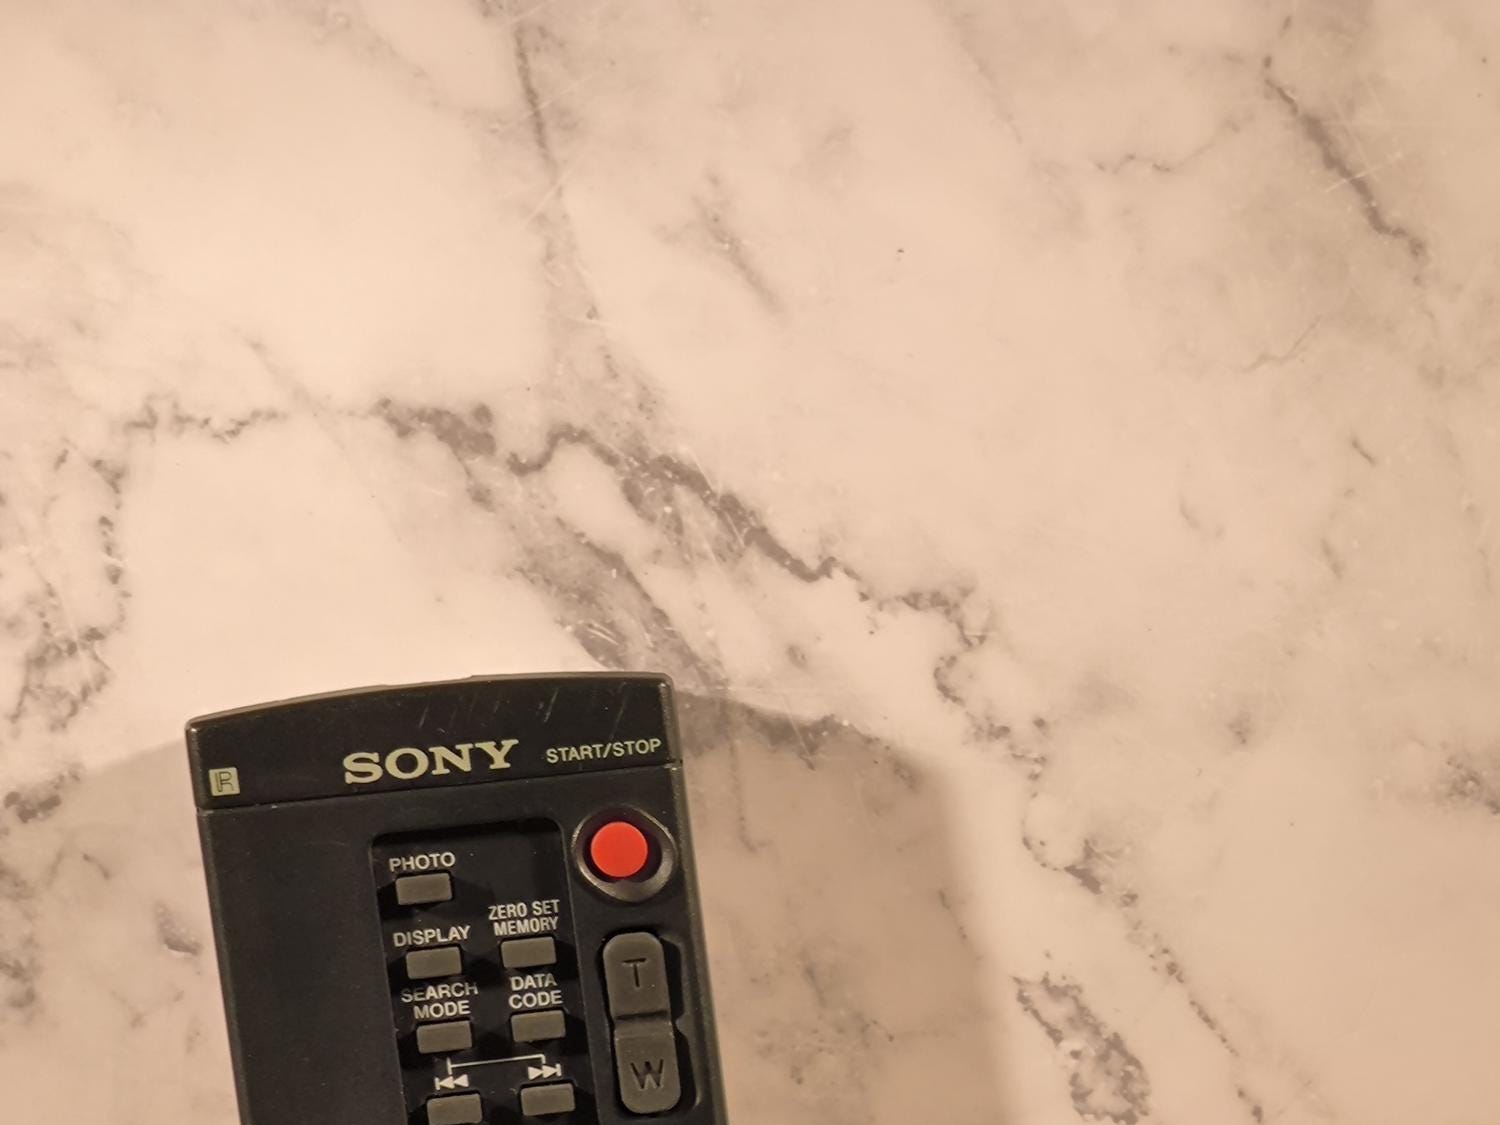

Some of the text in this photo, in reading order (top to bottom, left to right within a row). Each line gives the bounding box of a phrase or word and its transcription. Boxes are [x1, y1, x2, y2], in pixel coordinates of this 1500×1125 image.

[343, 738, 661, 785] SONY START/STOP
[389, 851, 456, 872] PHOTO
[488, 899, 560, 922] ZERO SET
[394, 925, 470, 947] DISPLAY
[493, 916, 559, 936] MEMORY
[510, 974, 557, 991] DATA
[622, 959, 646, 987] T
[401, 981, 478, 1004] SEARCH
[508, 990, 562, 1008] CODE
[414, 1000, 470, 1019] MODE
[632, 1061, 665, 1090] W
